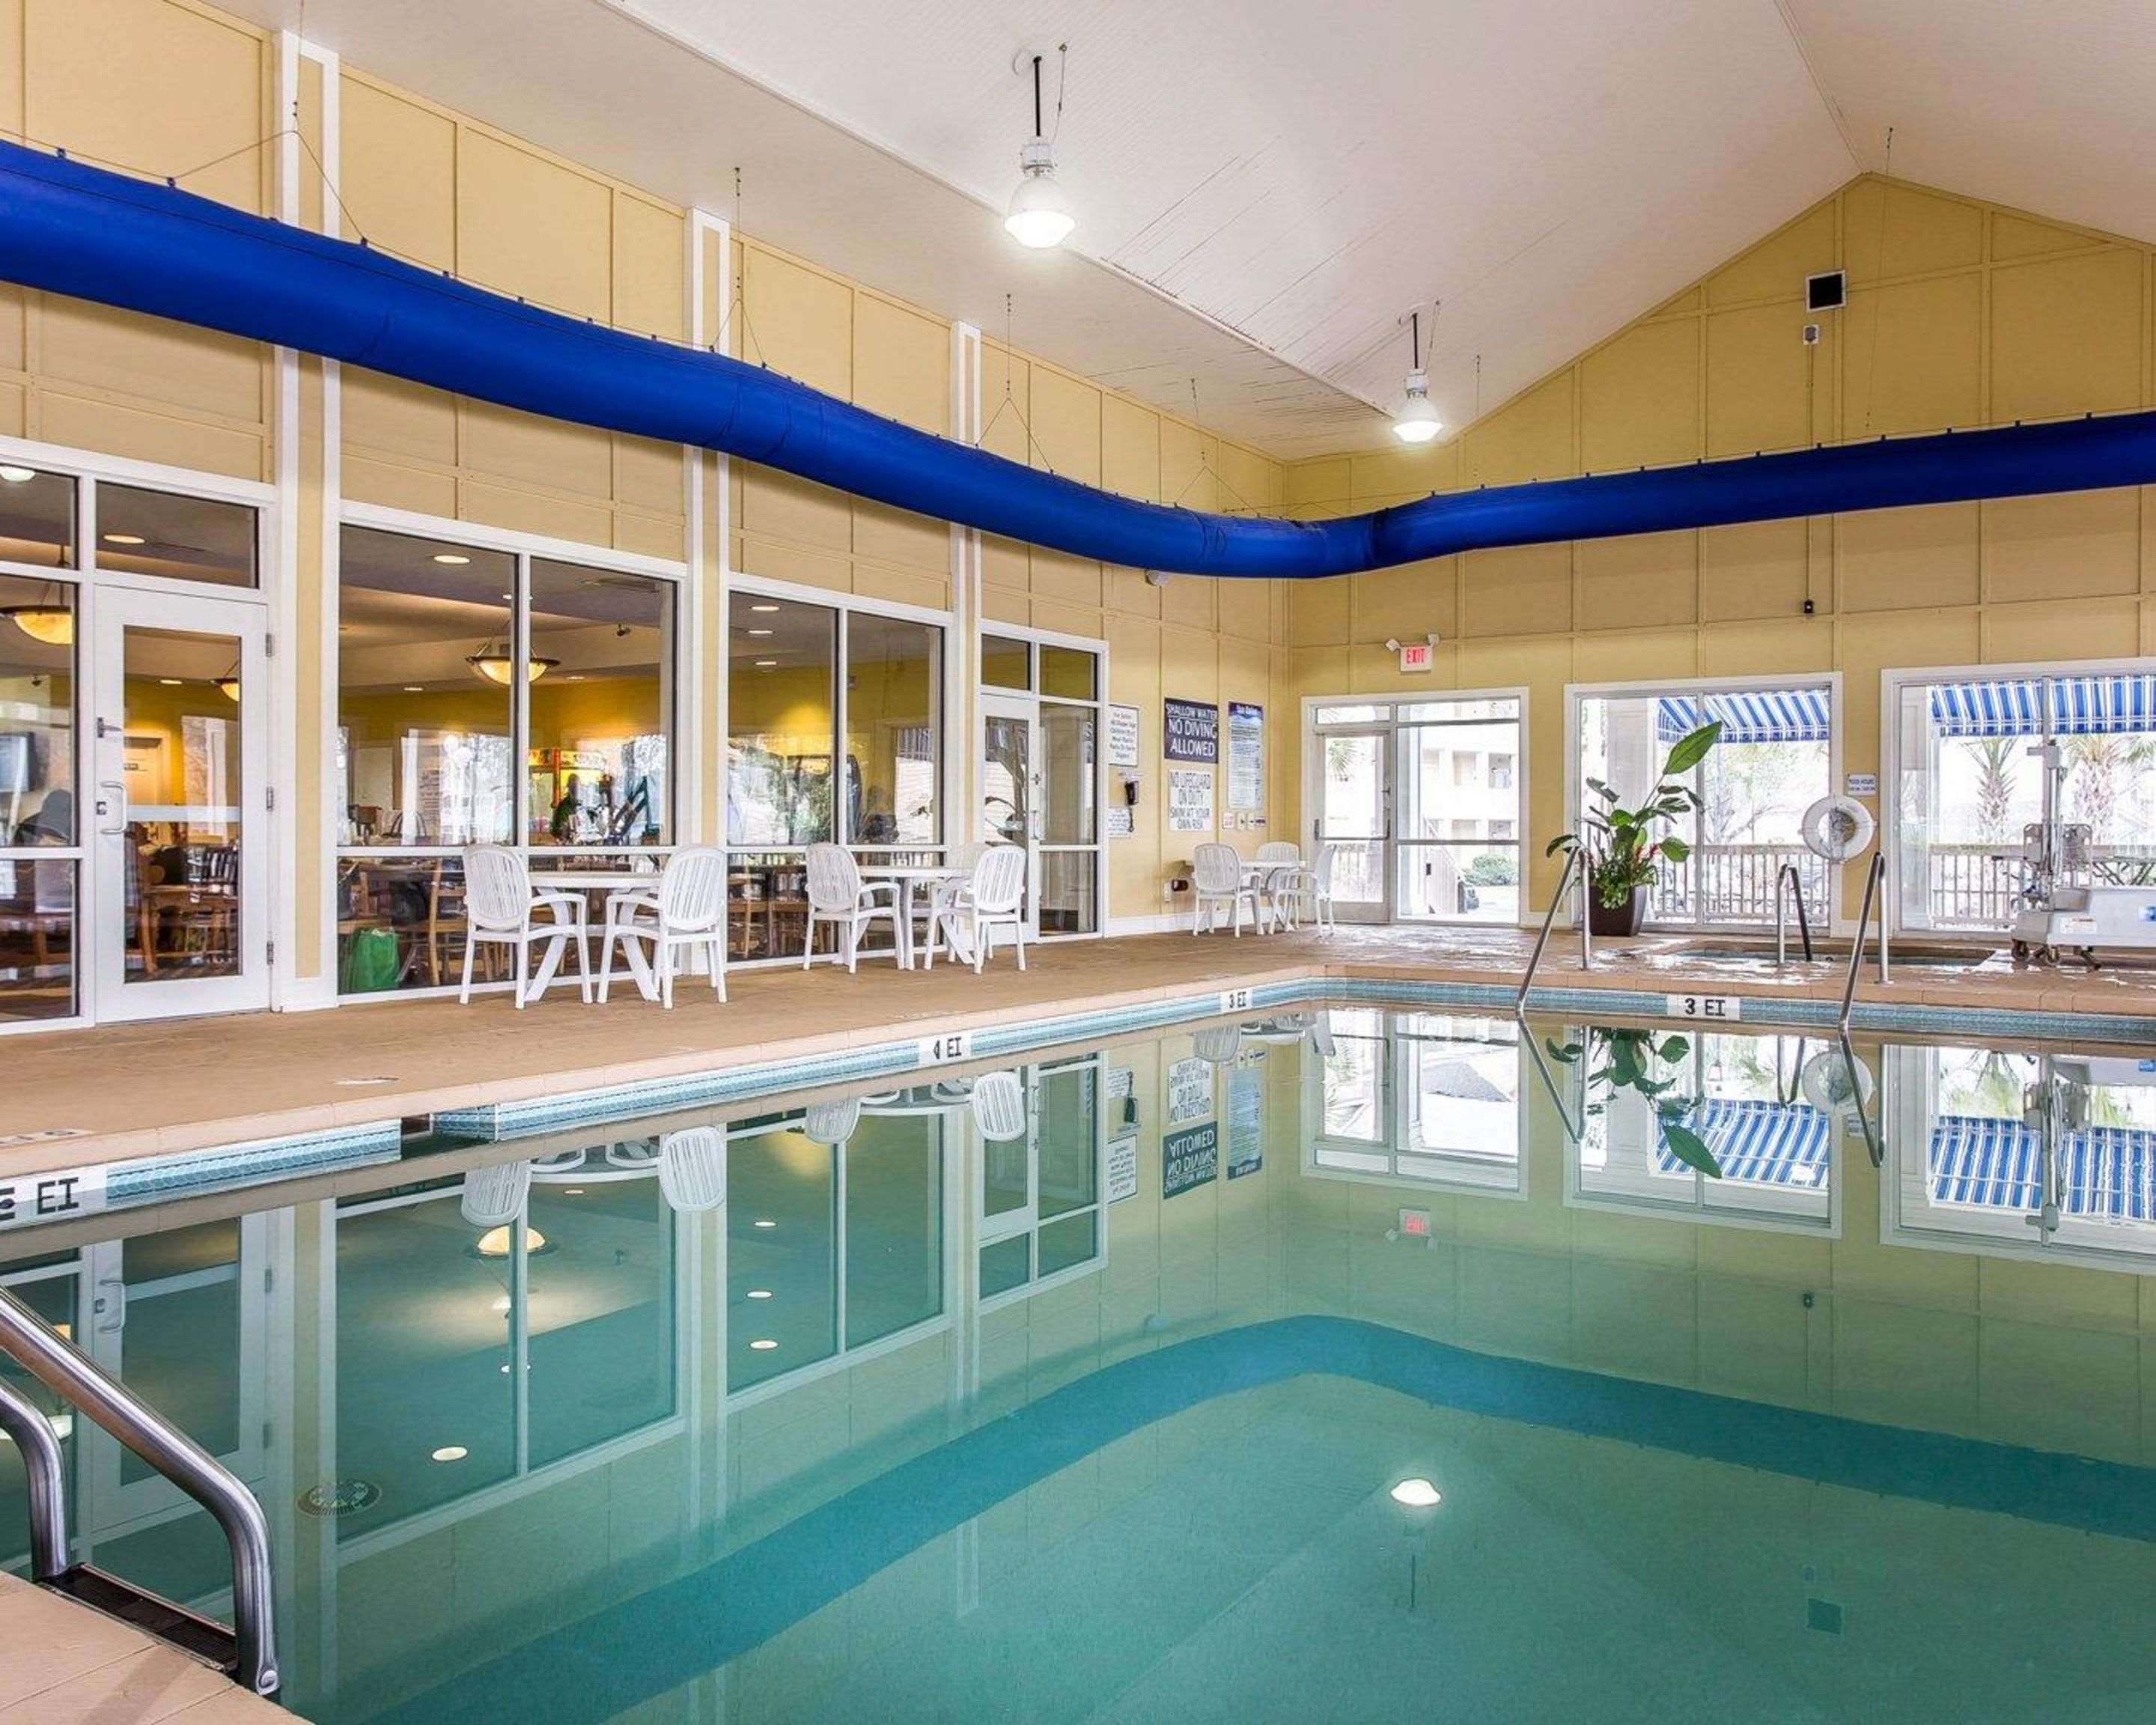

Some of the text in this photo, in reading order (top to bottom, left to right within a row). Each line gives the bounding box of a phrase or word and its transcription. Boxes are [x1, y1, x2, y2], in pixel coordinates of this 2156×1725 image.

[1406, 648, 1425, 664] EXIT
[1169, 718, 1217, 739] NO DIVING
[1169, 737, 1216, 757] ALLOWED
